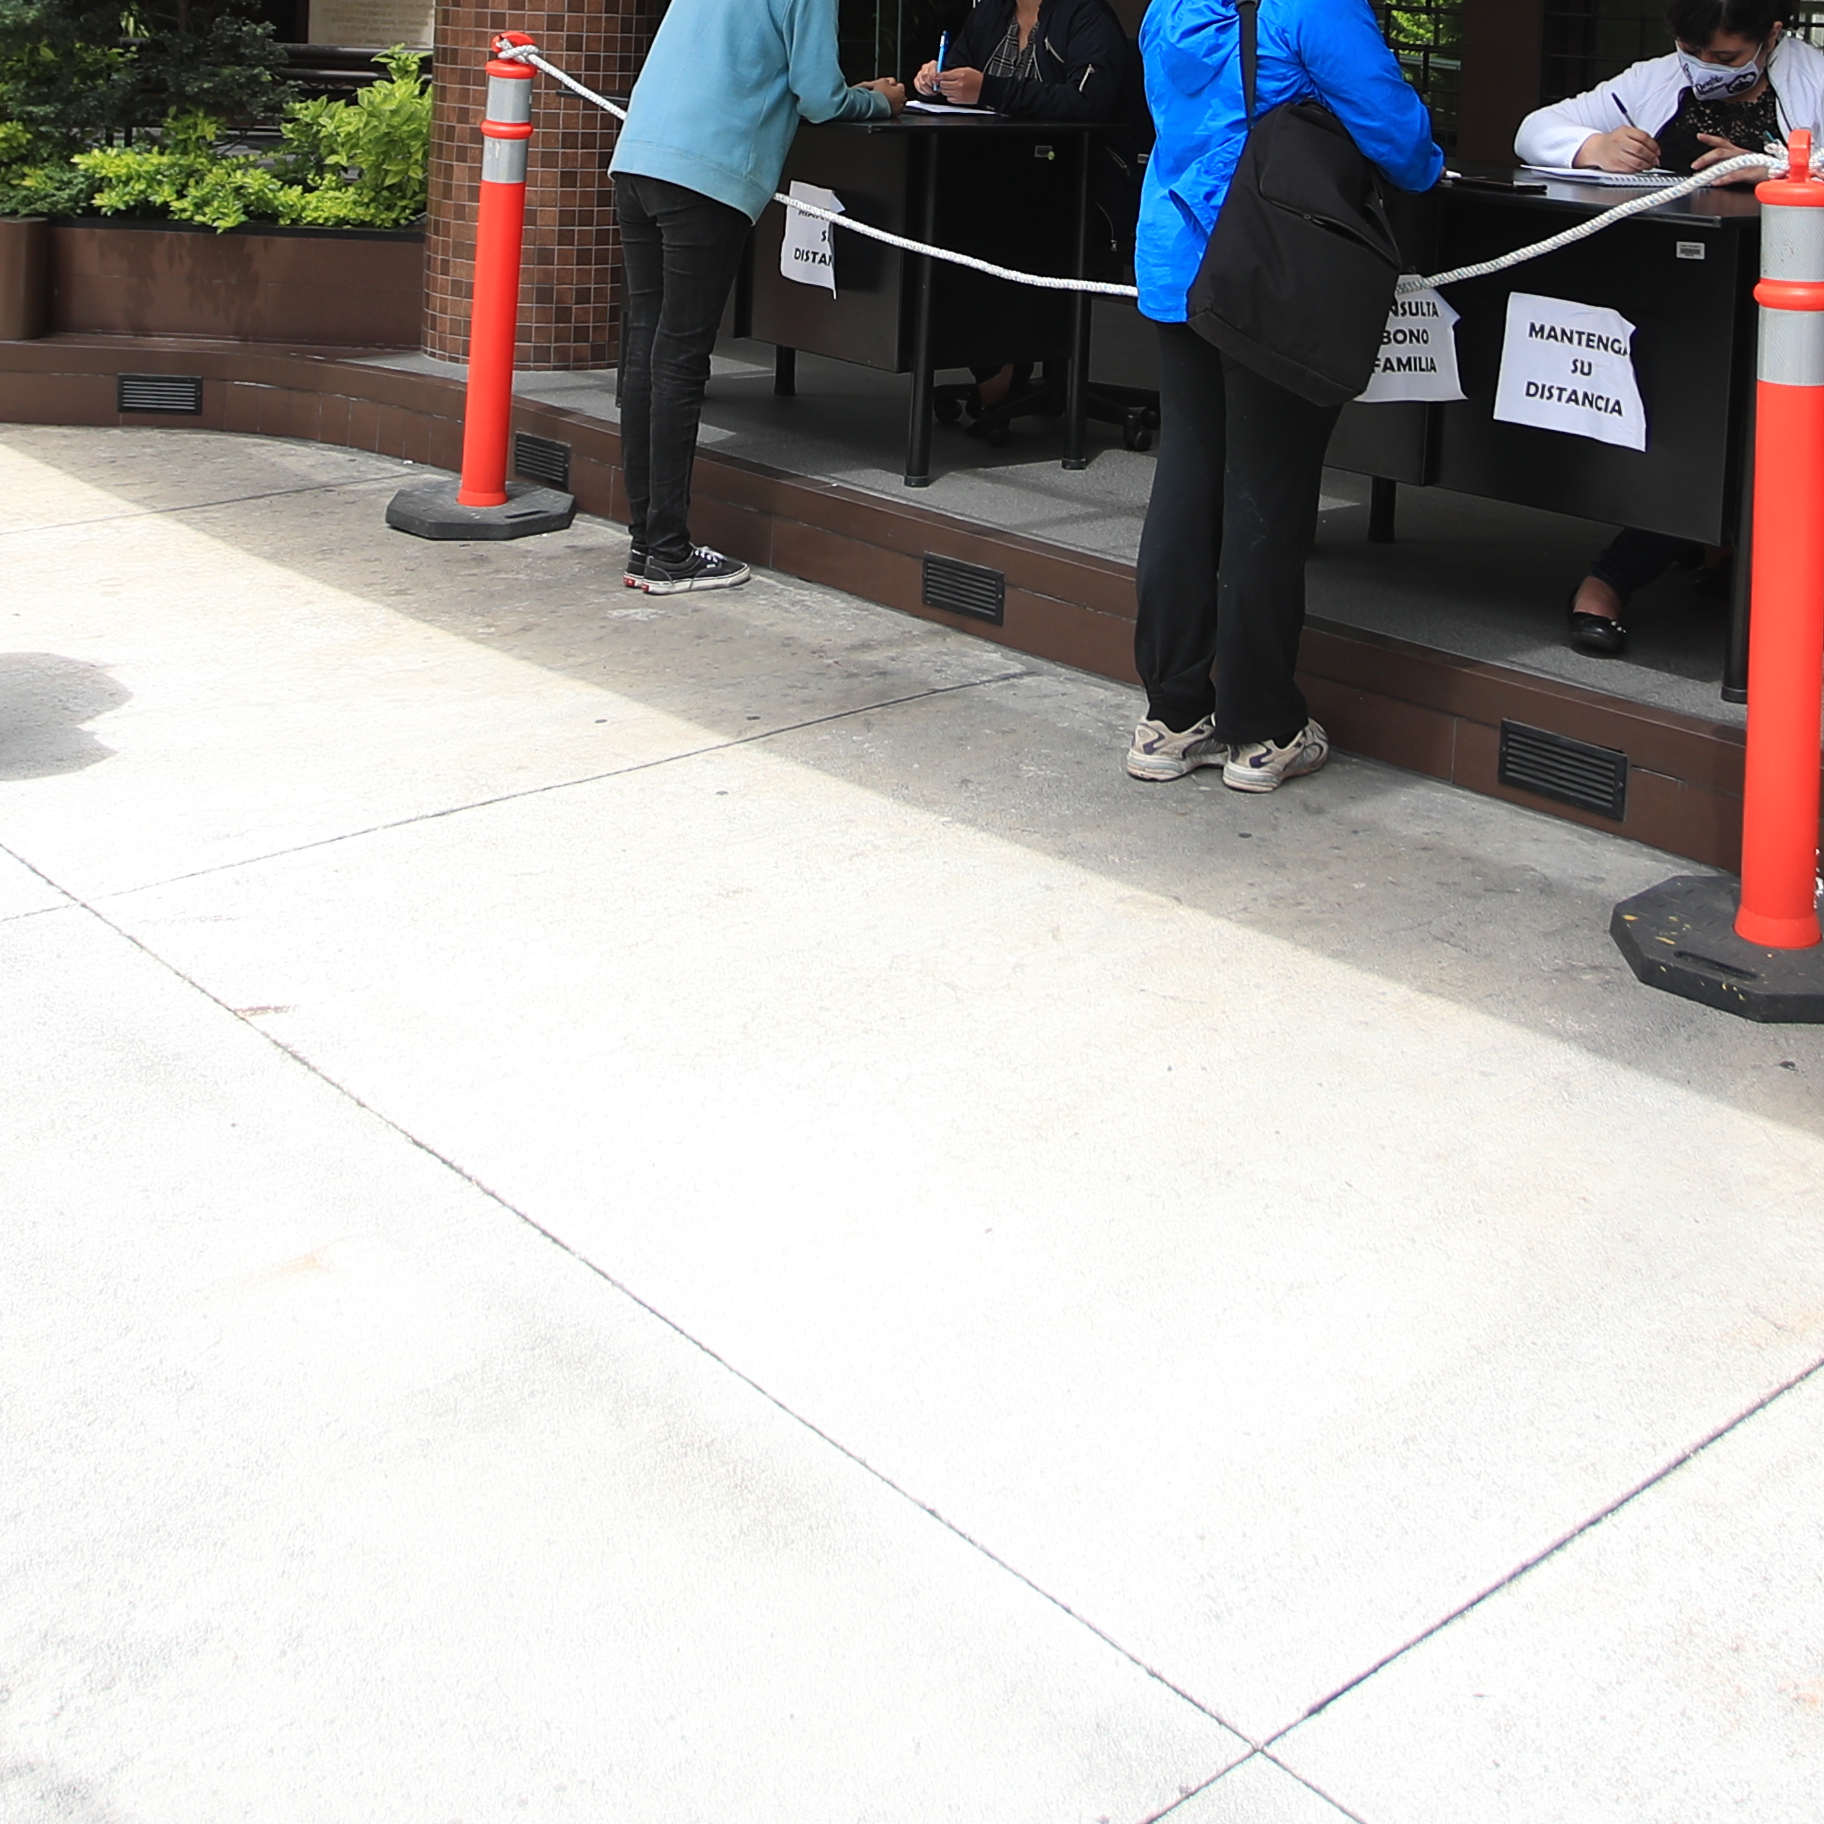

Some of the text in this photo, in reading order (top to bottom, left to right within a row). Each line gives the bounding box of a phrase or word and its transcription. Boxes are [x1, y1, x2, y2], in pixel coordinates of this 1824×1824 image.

[821, 230, 828, 242] S
[794, 248, 833, 266] DISTA
[1389, 301, 1440, 318] NSULTA
[1381, 328, 1430, 345] BONO
[1570, 358, 1593, 377] SU
[1525, 380, 1624, 417] DISTANCIA
